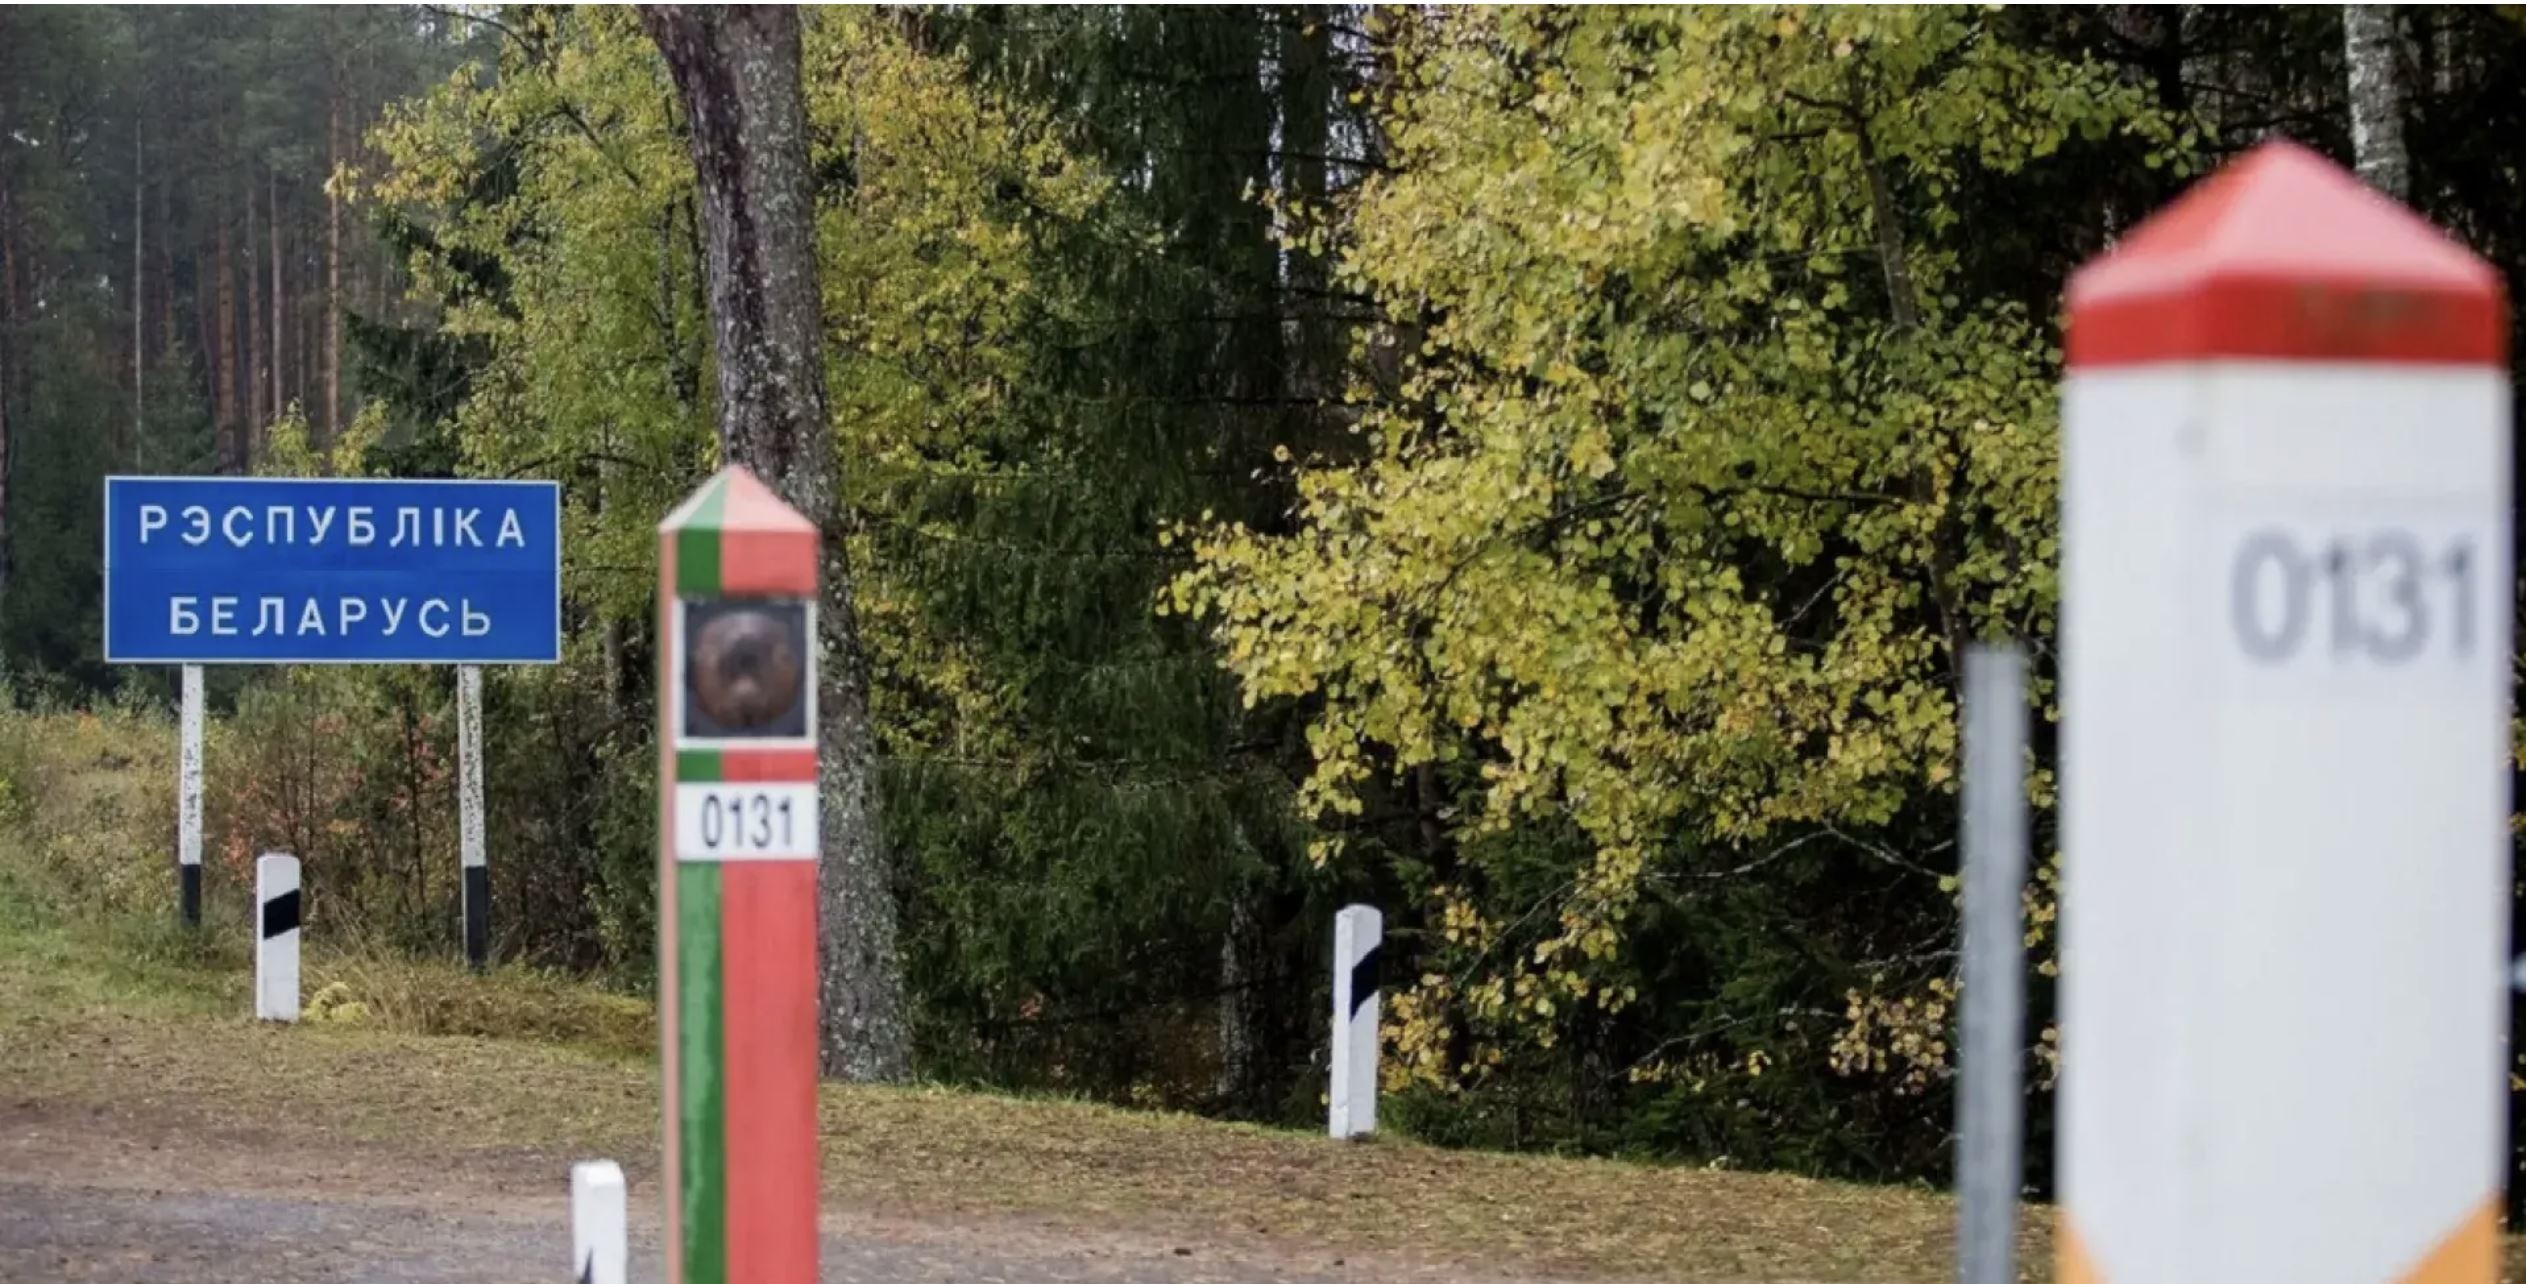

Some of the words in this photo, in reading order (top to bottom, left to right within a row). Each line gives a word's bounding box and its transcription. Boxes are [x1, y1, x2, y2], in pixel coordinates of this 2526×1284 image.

[139, 505, 526, 548] РЭСПУБЛІКА
[169, 597, 491, 638] БЕЛАРУСЬ
[2229, 526, 2478, 667] 0131
[701, 794, 793, 848] 0131
